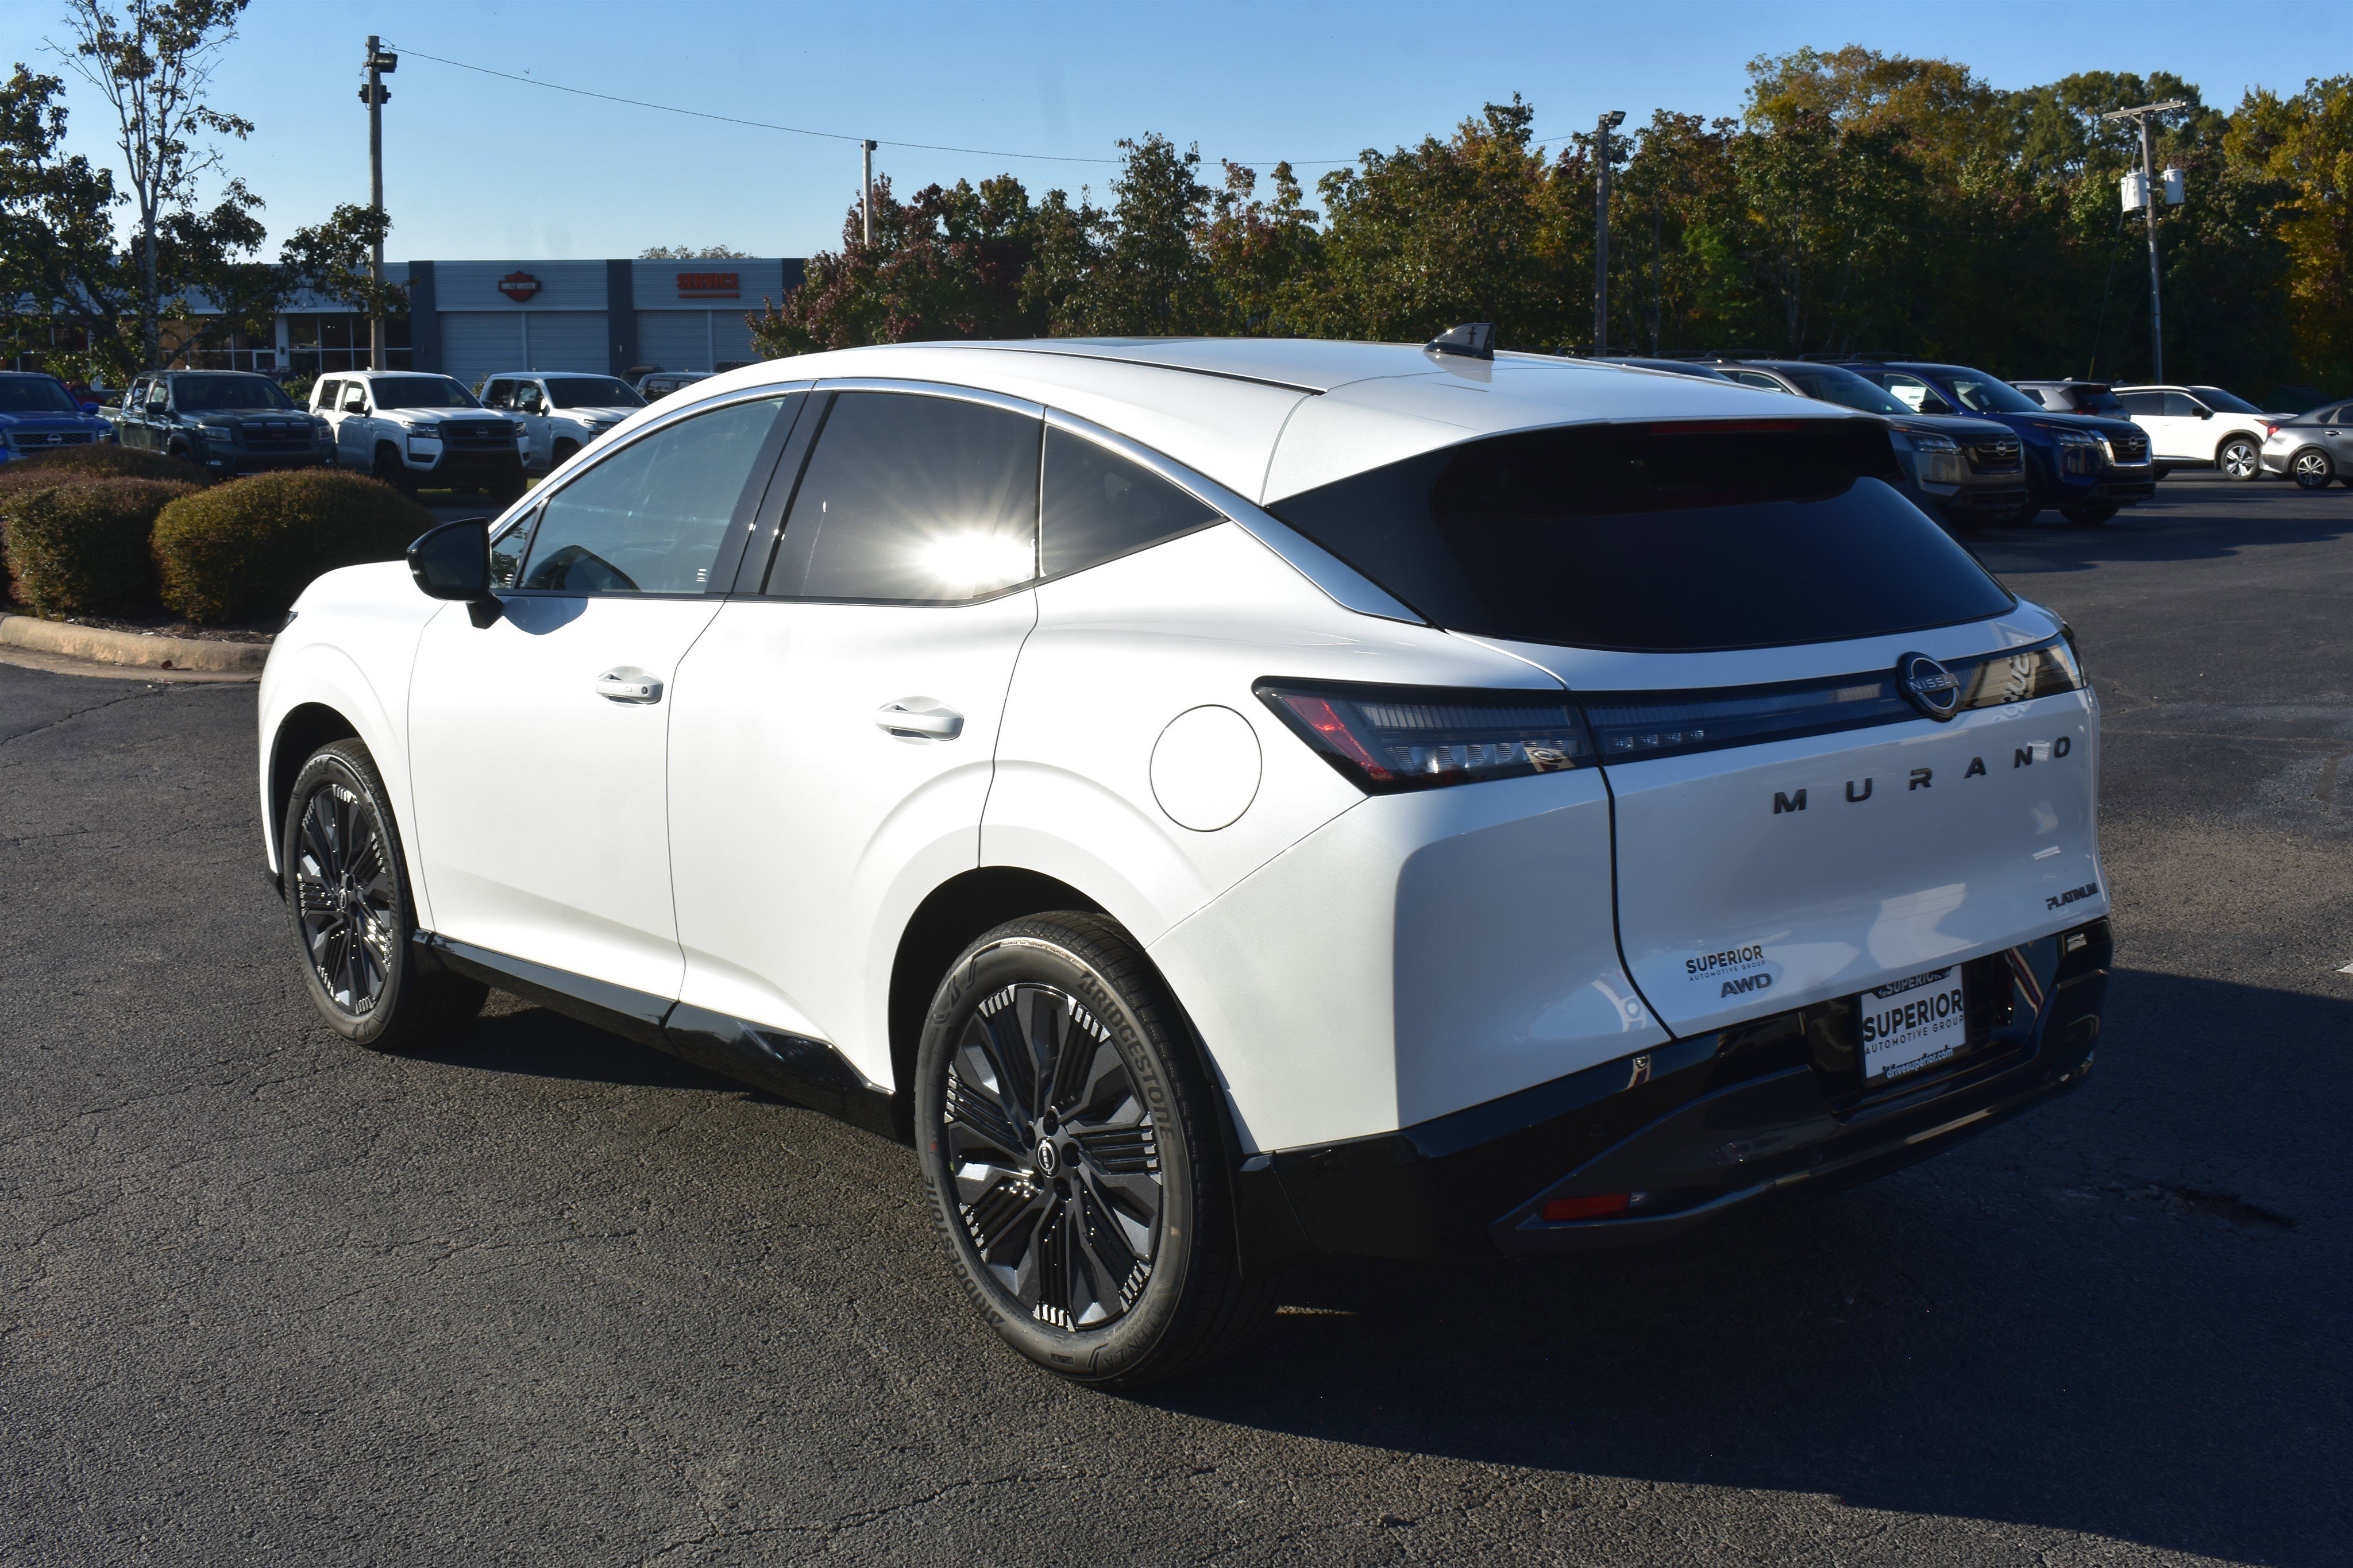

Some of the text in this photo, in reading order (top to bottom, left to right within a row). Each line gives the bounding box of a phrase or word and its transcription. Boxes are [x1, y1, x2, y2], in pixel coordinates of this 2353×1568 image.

[677, 272, 739, 289] SERVICE
[1909, 676, 1958, 690] NISSAN
[1773, 735, 2071, 814] MURANO
[2045, 882, 2099, 910] PLATINUM
[1685, 945, 1764, 974] SUPERIOR
[1689, 960, 1765, 982] AUTOMOTIVE GROUP
[1721, 973, 1772, 998] AWD
[1863, 988, 1963, 1042] SUPERIOR
[1865, 1015, 1964, 1055] AUTOMOTIVE GROUP
[1077, 970, 1176, 1141] BRIDGESTONE
[1886, 1046, 1953, 1079] drivesuperior.com
[922, 1175, 1005, 1331] BRIDGESTONE
[1104, 1302, 1164, 1368] ALENZA
